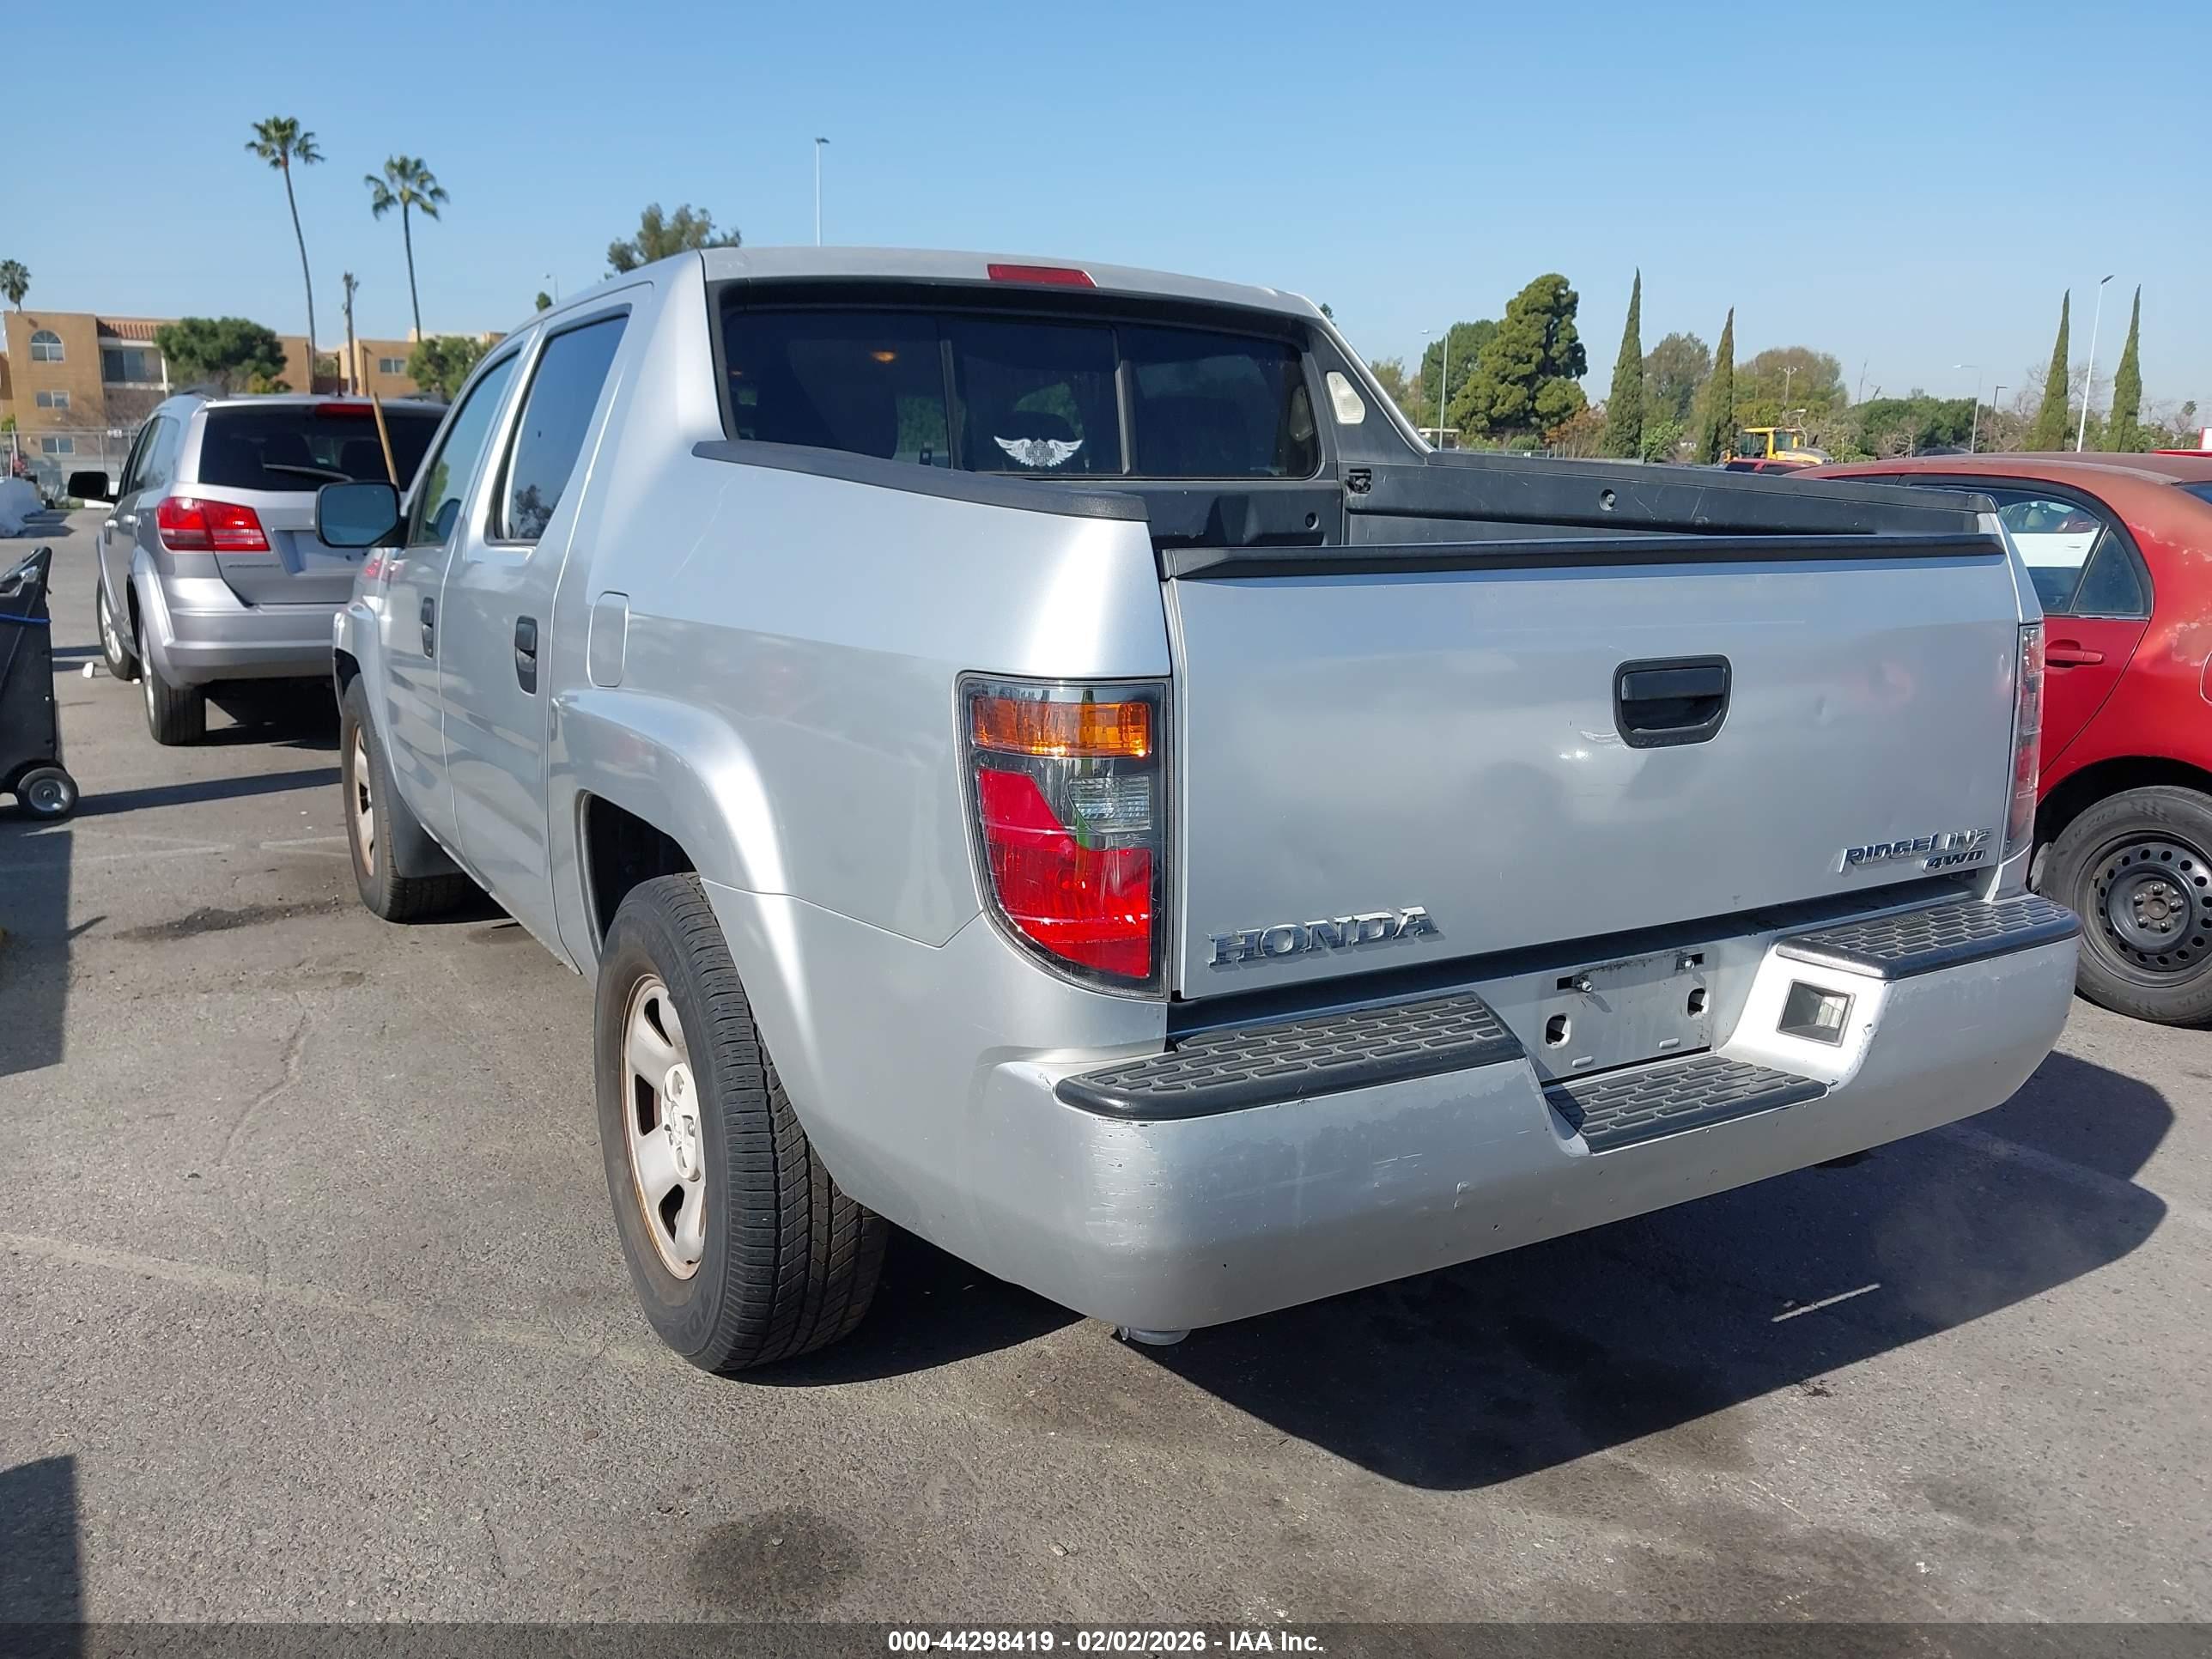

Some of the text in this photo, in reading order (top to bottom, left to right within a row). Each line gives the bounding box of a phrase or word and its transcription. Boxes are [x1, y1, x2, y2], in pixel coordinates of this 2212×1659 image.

[1838, 827, 1992, 873] RIDGELINE
[1923, 849, 1986, 872] 4WD
[1207, 906, 1441, 967] HONDA
